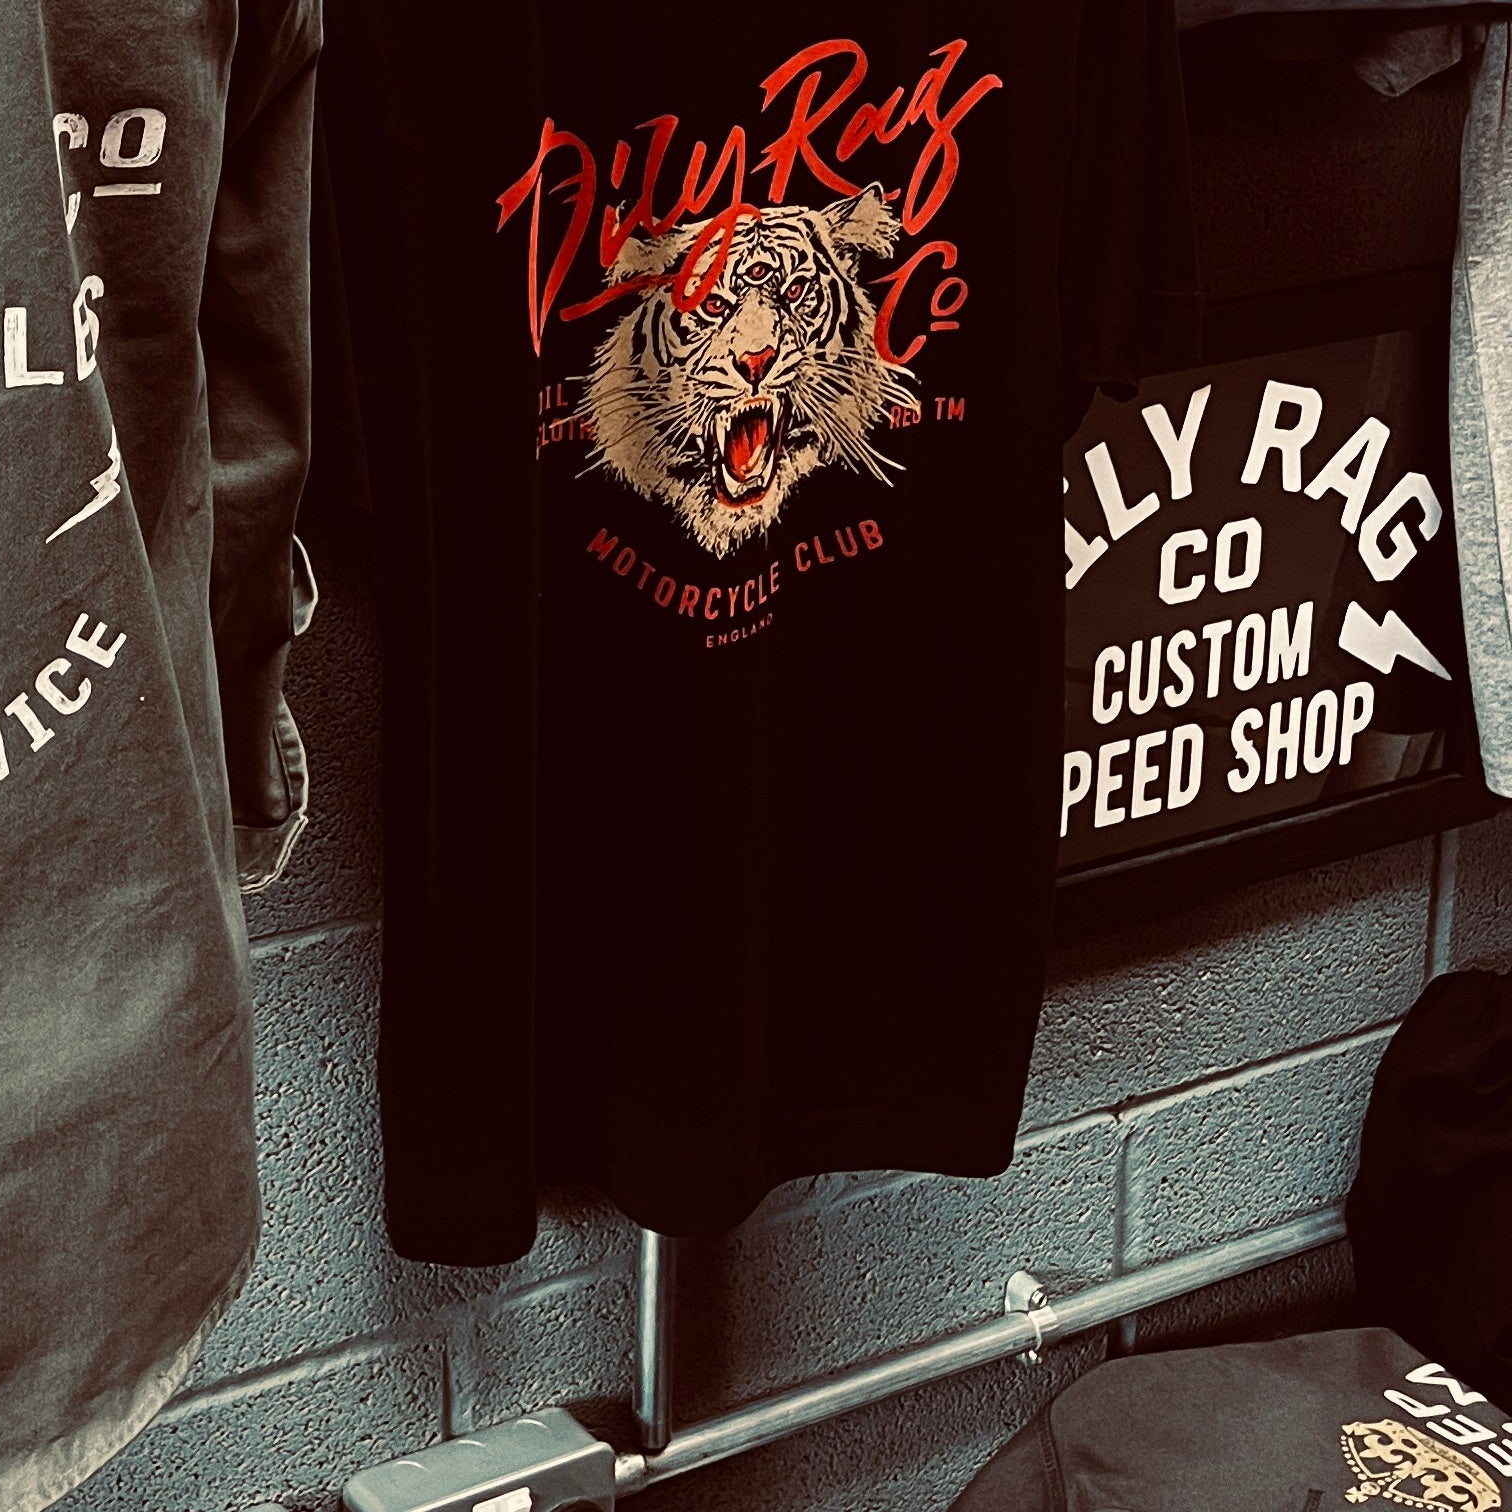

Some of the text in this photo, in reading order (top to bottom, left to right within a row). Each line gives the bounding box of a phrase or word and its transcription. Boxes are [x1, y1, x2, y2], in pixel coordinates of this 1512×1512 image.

[750, 38, 1005, 236] Rag
[868, 240, 970, 366] Co
[934, 396, 966, 422] TM
[1240, 379, 1443, 583] RAG
[586, 519, 884, 620] MOTORCYCLE CLUB
[1158, 517, 1262, 605] CO
[705, 612, 774, 649] ENGLAND
[1092, 601, 1314, 724] CUSTOM
[1059, 681, 1375, 838] PEED SHOP
